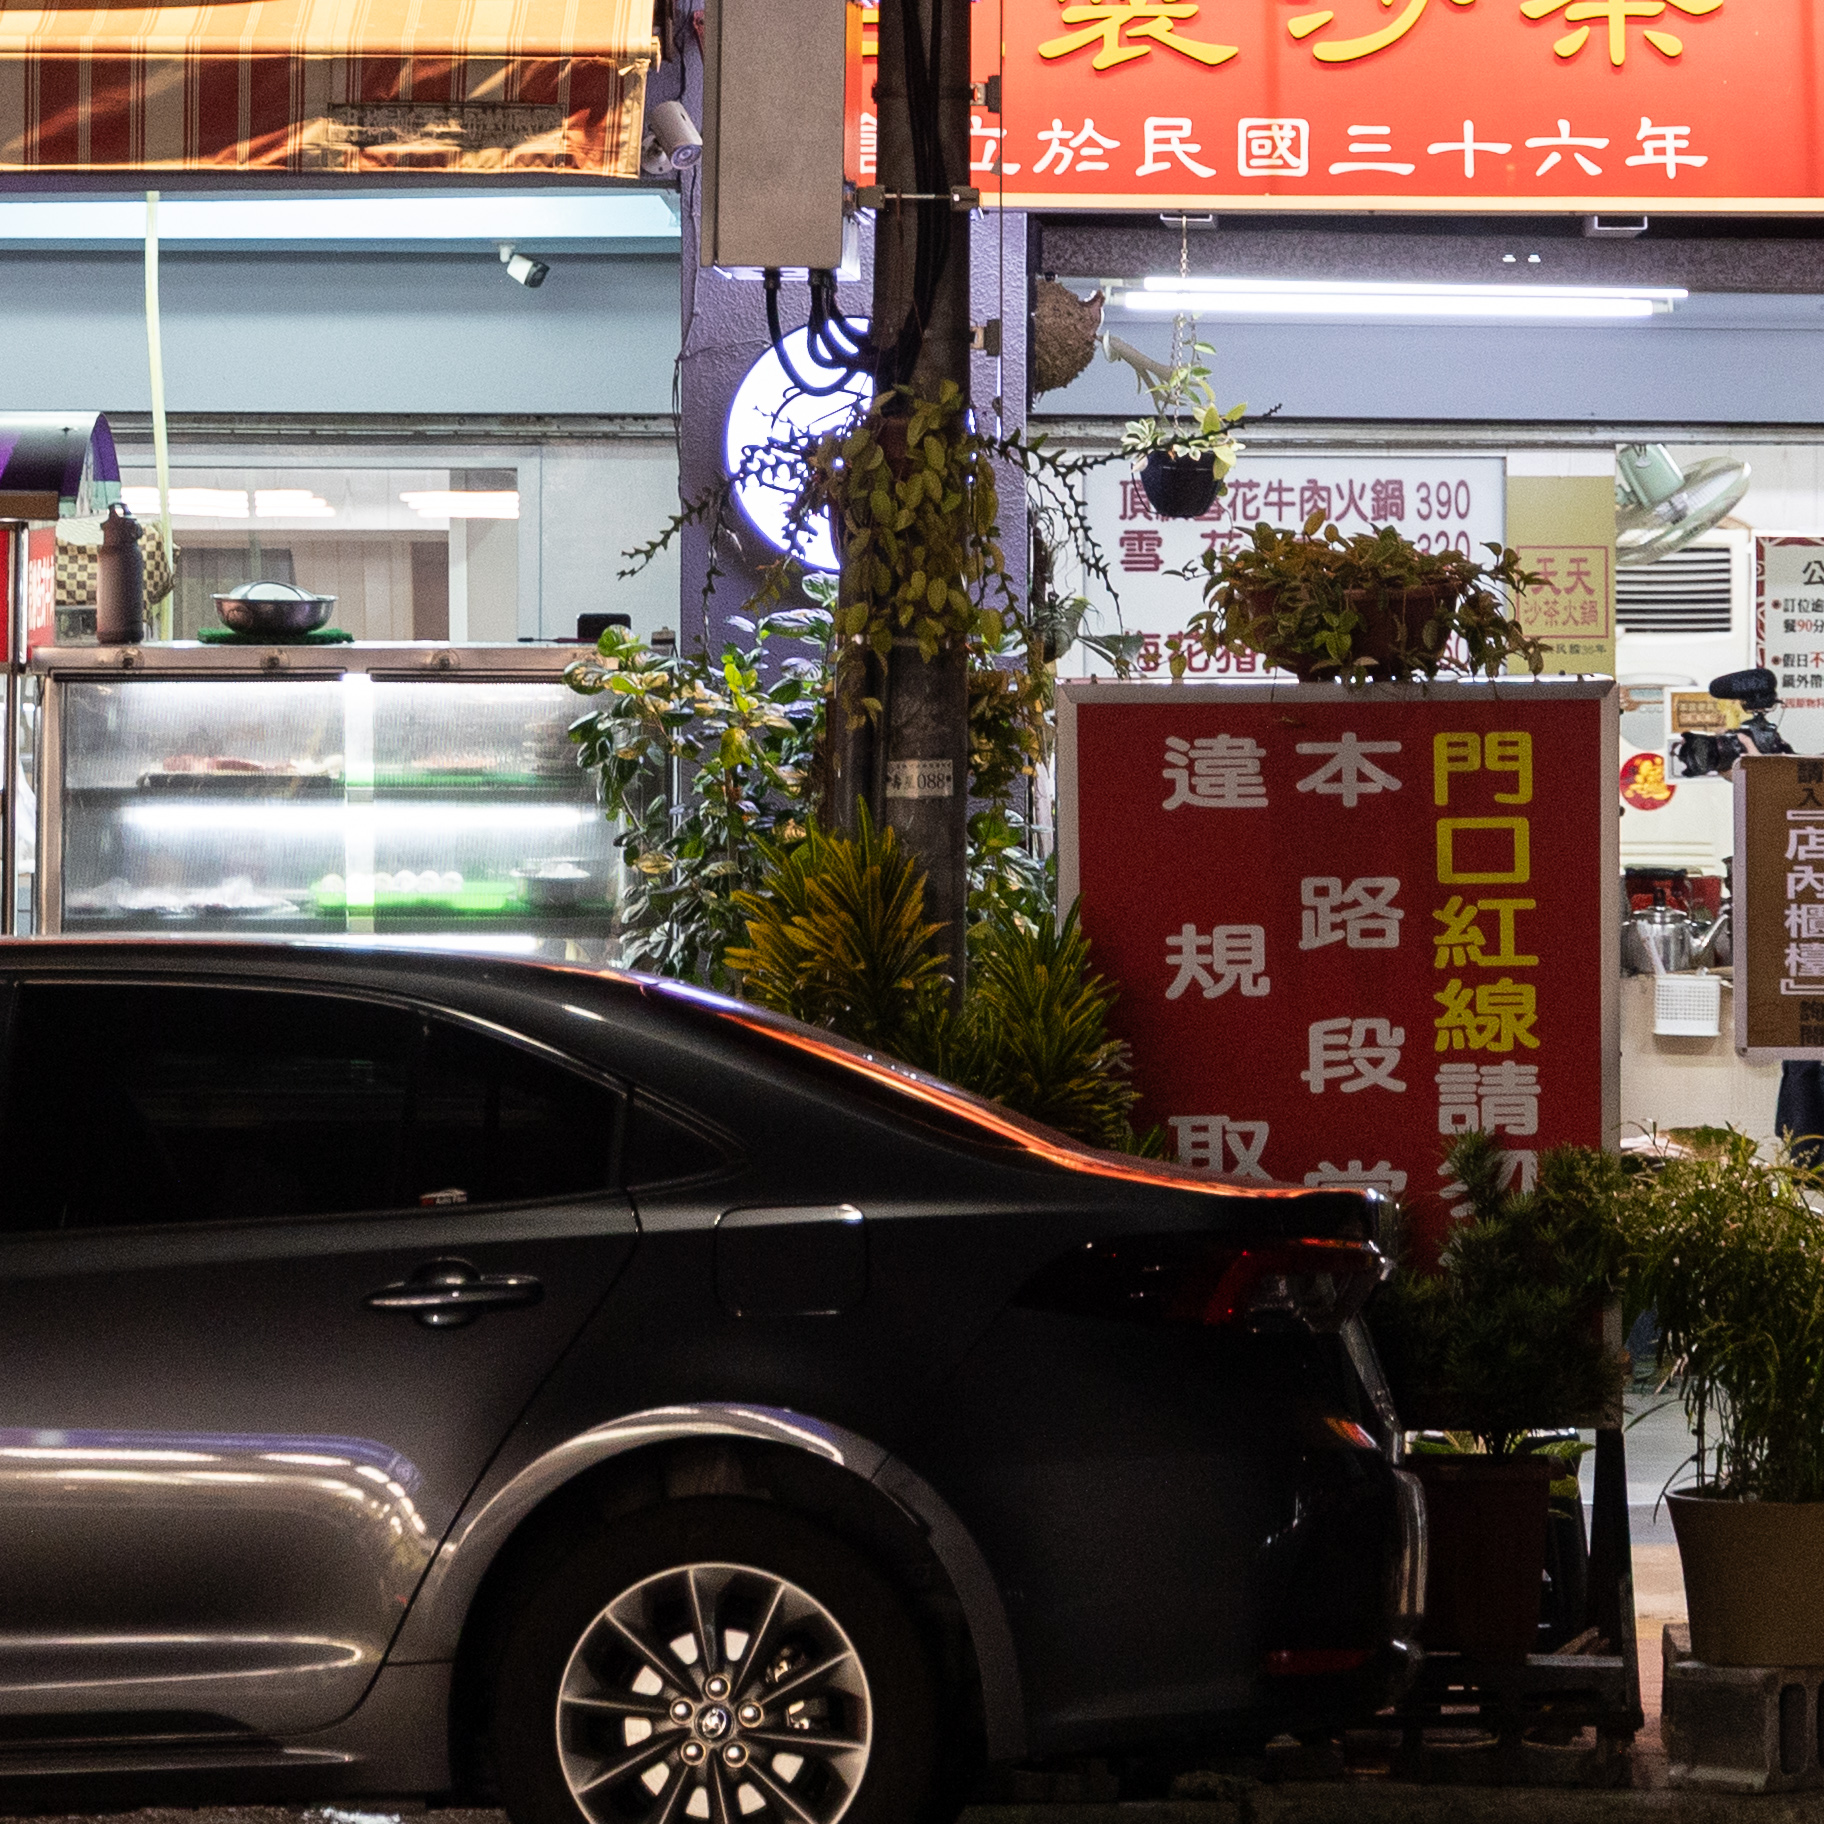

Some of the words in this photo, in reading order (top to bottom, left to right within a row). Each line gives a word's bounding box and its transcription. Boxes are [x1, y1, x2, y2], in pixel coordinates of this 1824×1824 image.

[860, 114, 1708, 178] 立於民國三十六年
[1119, 478, 1405, 522] 頂花牛肉火鍋
[1416, 479, 1471, 521] 390
[1530, 557, 1595, 596] 天天
[1122, 630, 1273, 674] 梅花豬
